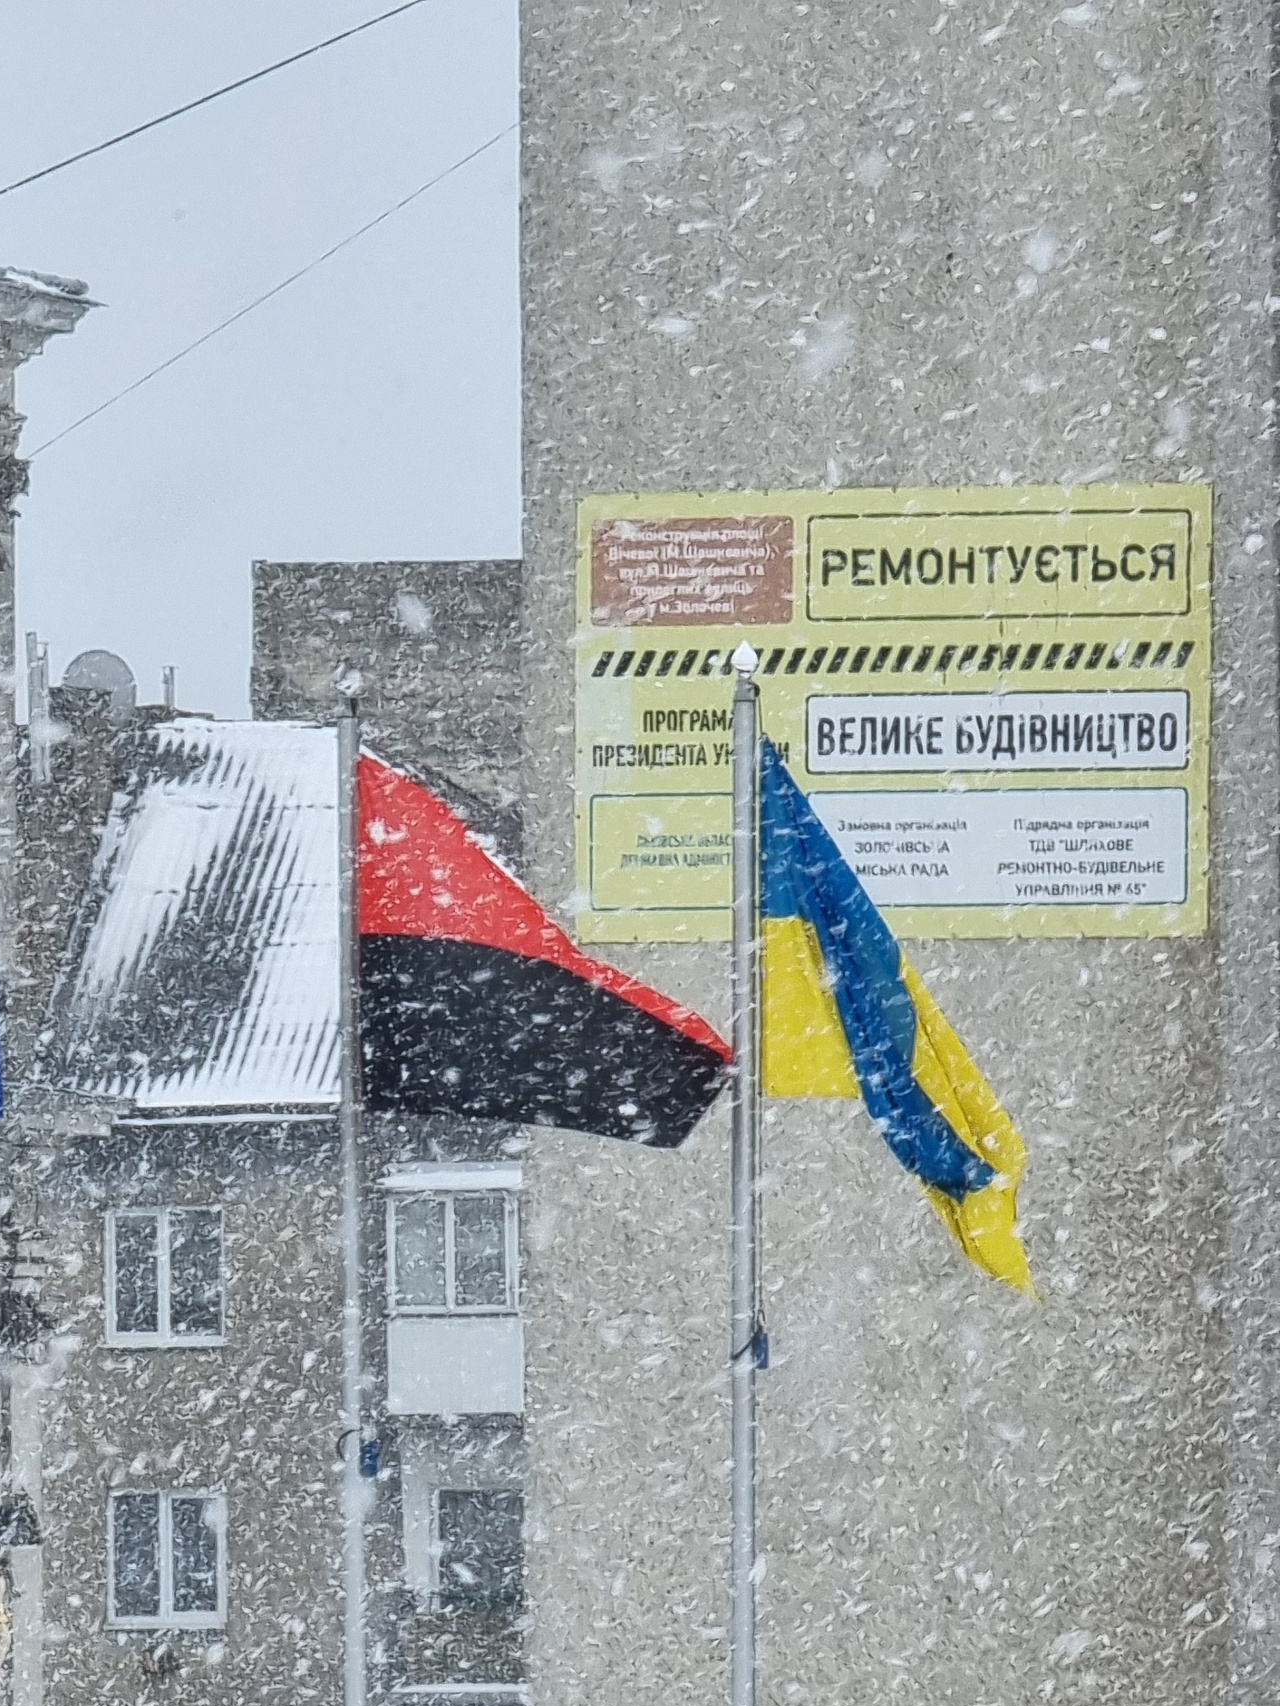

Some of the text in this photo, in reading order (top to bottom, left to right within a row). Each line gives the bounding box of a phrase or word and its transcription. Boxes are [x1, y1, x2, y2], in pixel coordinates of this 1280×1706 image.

[620, 529, 717, 543] еконструкція
[749, 564, 765, 576] та
[821, 543, 1175, 587] РЕМОНТУЄТЬСЯ
[817, 715, 944, 756] ВЕЛИКЕ
[955, 712, 1178, 761] БУДІВНИЦТВО
[592, 743, 708, 770] ПРЕЗИДЕНТА
[854, 840, 950, 854] ЗОЛОЧІВСЬА
[855, 863, 906, 877] МІСЬКА
[997, 860, 1166, 876] РЕМОНТНО-БУДІВЕЛЬНЕ
